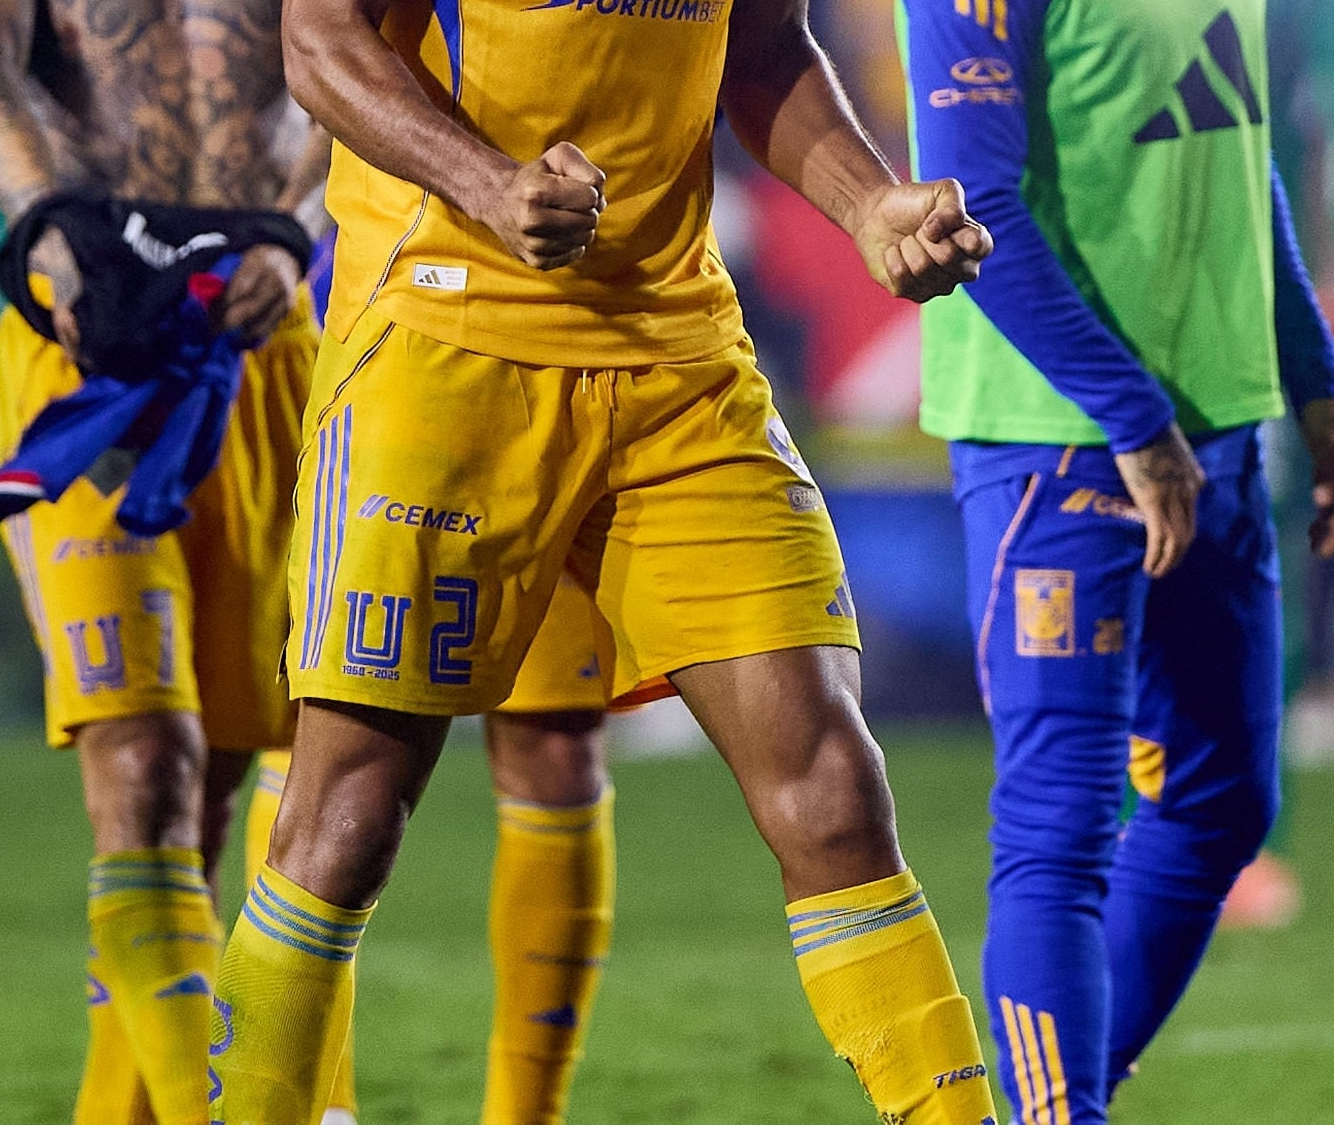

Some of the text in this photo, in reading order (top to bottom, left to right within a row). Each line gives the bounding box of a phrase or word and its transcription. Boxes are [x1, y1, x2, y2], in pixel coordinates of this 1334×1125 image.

[385, 502, 483, 535] CEMEX
[345, 591, 413, 669] U
[429, 575, 479, 686] 2
